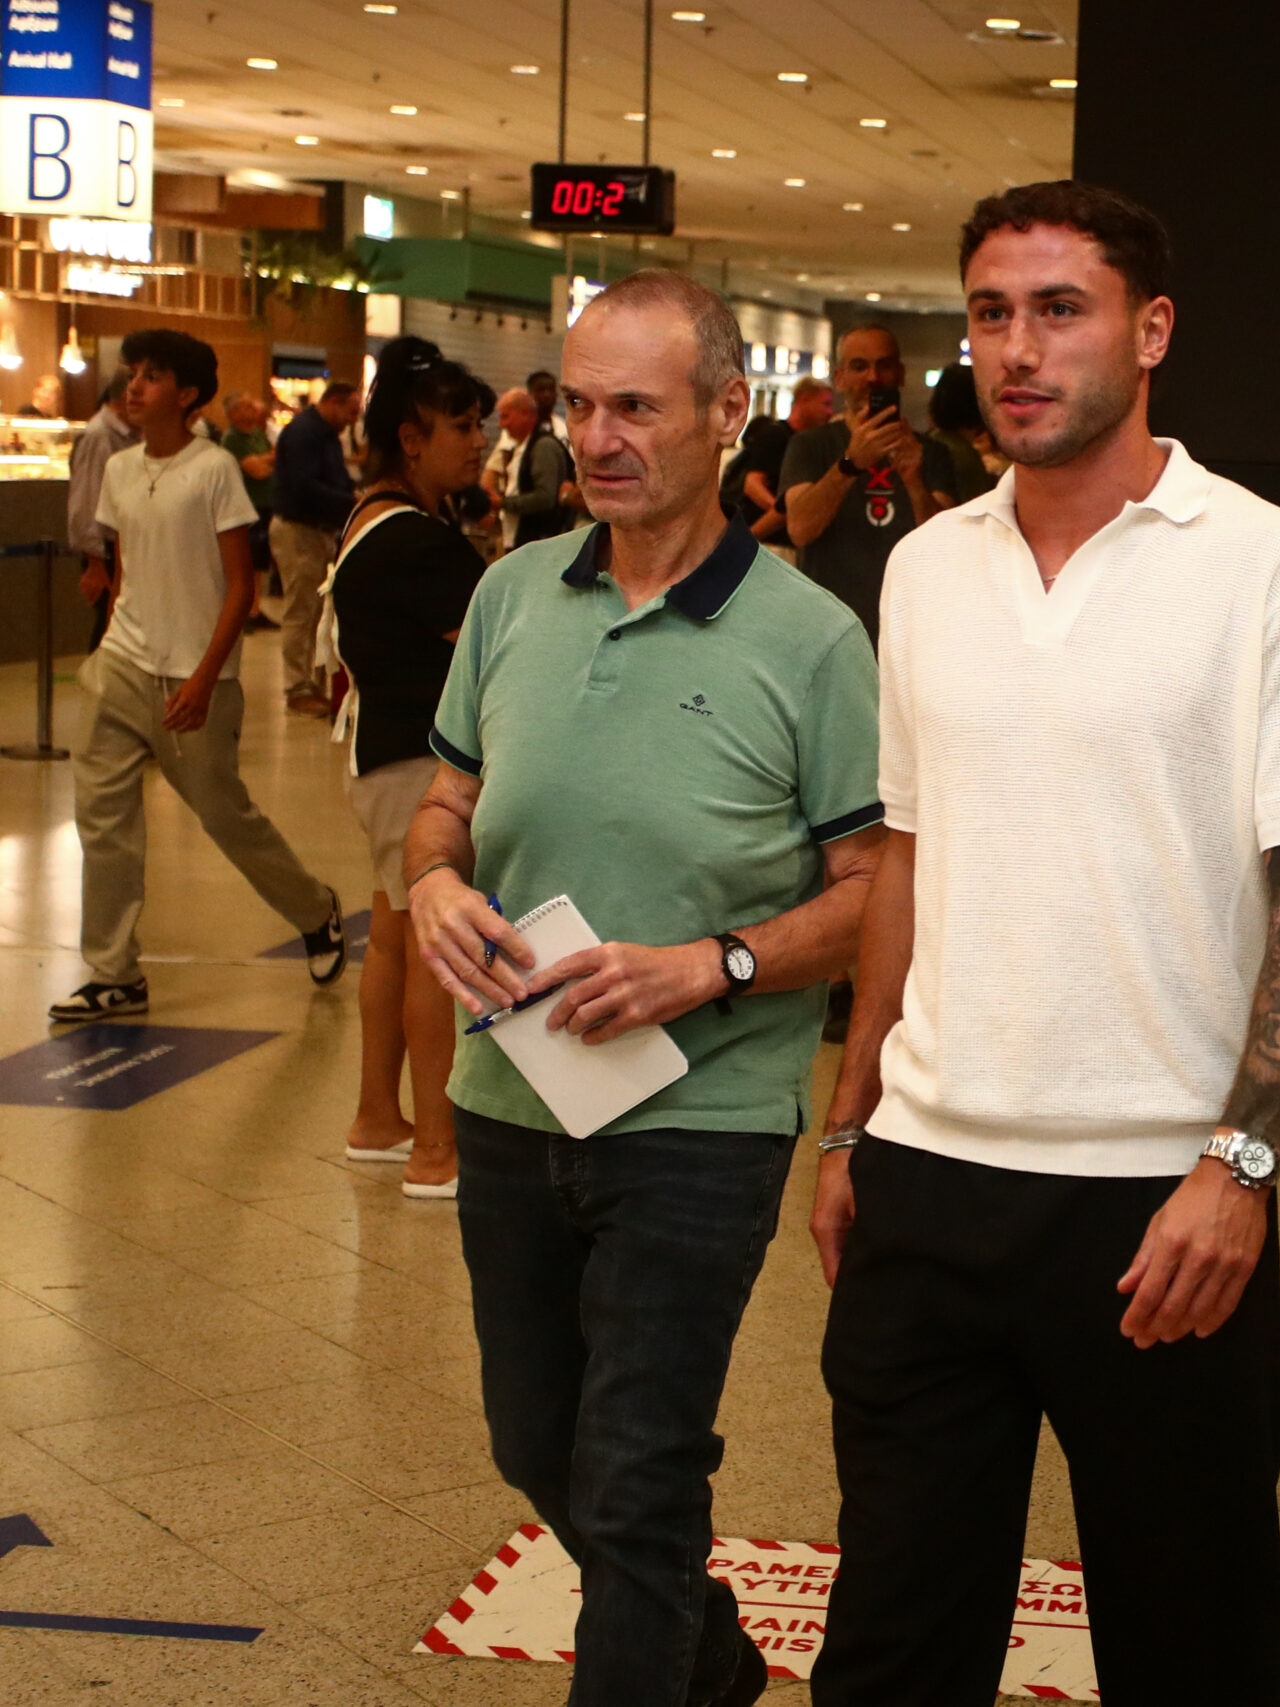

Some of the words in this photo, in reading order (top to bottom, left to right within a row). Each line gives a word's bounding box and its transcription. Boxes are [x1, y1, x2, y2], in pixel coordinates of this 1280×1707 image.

[28, 113, 71, 201] B
[117, 119, 136, 208] B
[551, 180, 626, 216] 00:2
